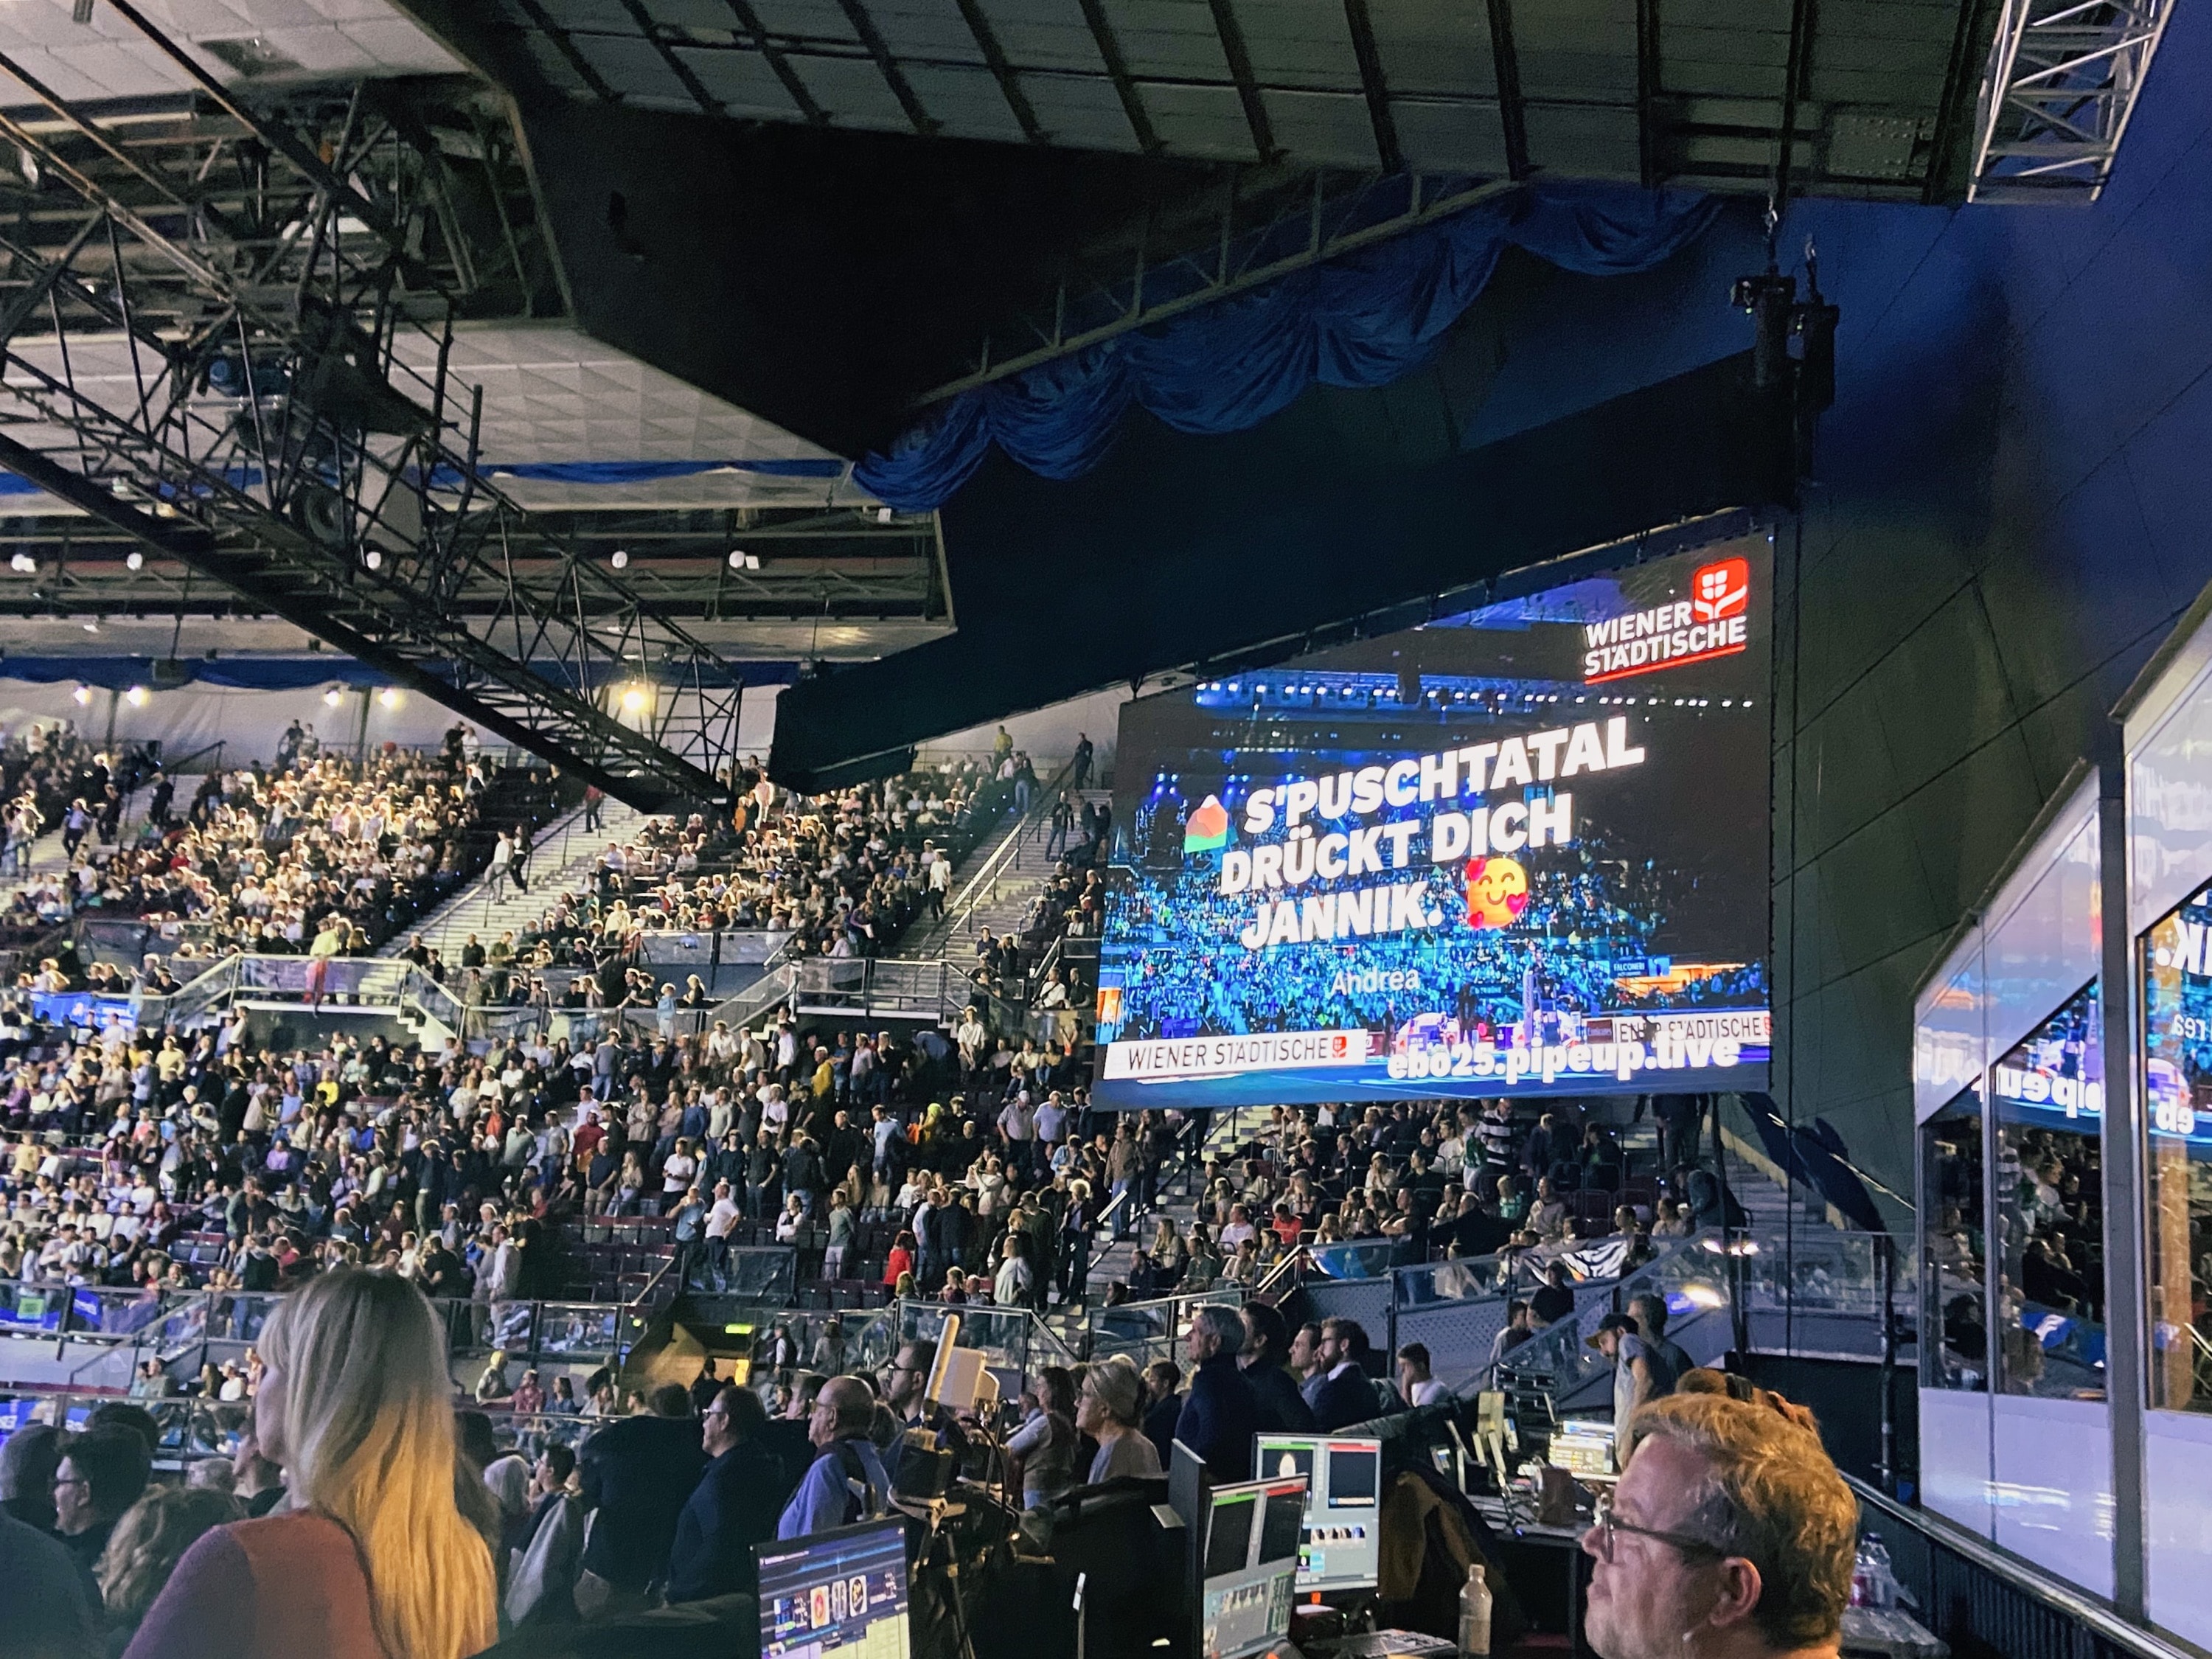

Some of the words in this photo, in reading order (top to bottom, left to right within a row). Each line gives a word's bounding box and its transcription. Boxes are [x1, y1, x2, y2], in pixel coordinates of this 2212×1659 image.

[1585, 602, 1692, 648] WIENER
[1585, 616, 1747, 675] STÄDTISCHE
[1244, 717, 1645, 833] S'PUSCHTATAL
[1219, 819, 1419, 894] DRÜCKT
[1432, 793, 1572, 862] DICH
[1241, 880, 1443, 949] JANNIK.
[1331, 967, 1419, 996] Andrea
[1129, 1043, 1206, 1070] WIENER
[1214, 1037, 1329, 1065] STÄDTISCHE
[1388, 1030, 1741, 1085] ebo25.pipeup.live
